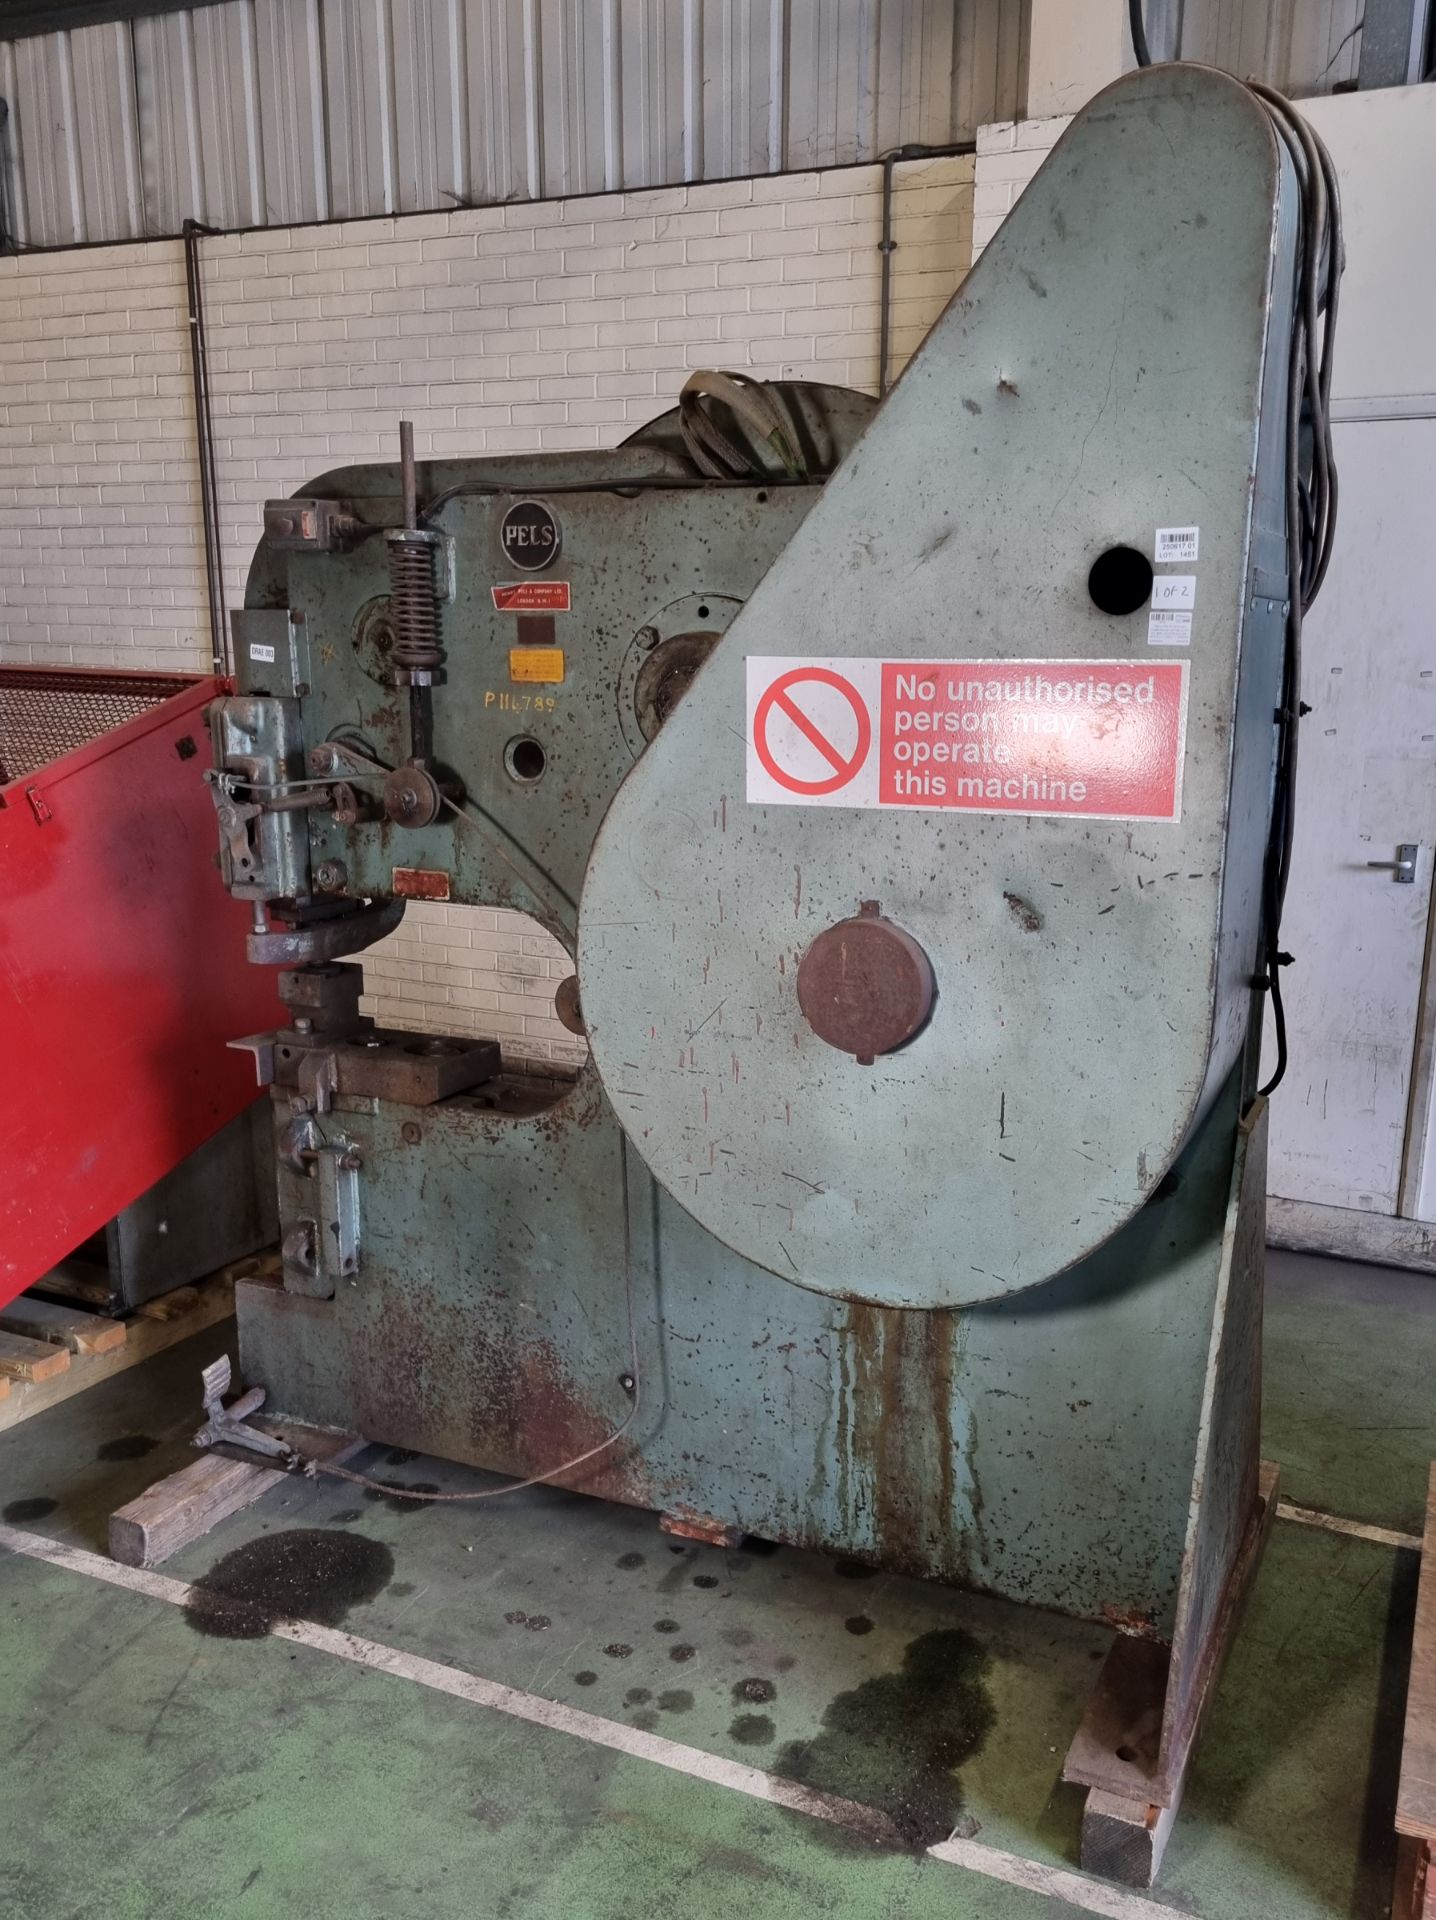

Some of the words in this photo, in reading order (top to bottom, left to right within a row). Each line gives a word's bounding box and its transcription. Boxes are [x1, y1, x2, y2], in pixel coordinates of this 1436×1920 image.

[506, 525, 552, 546] PELS
[1181, 586, 1189, 597] 2
[895, 674, 936, 701] No
[947, 676, 1155, 703] unauthorised
[894, 710, 1000, 735] person
[1013, 711, 1079, 738] may
[894, 740, 1010, 766] operate
[894, 769, 947, 796] this
[957, 774, 1087, 801] machine
